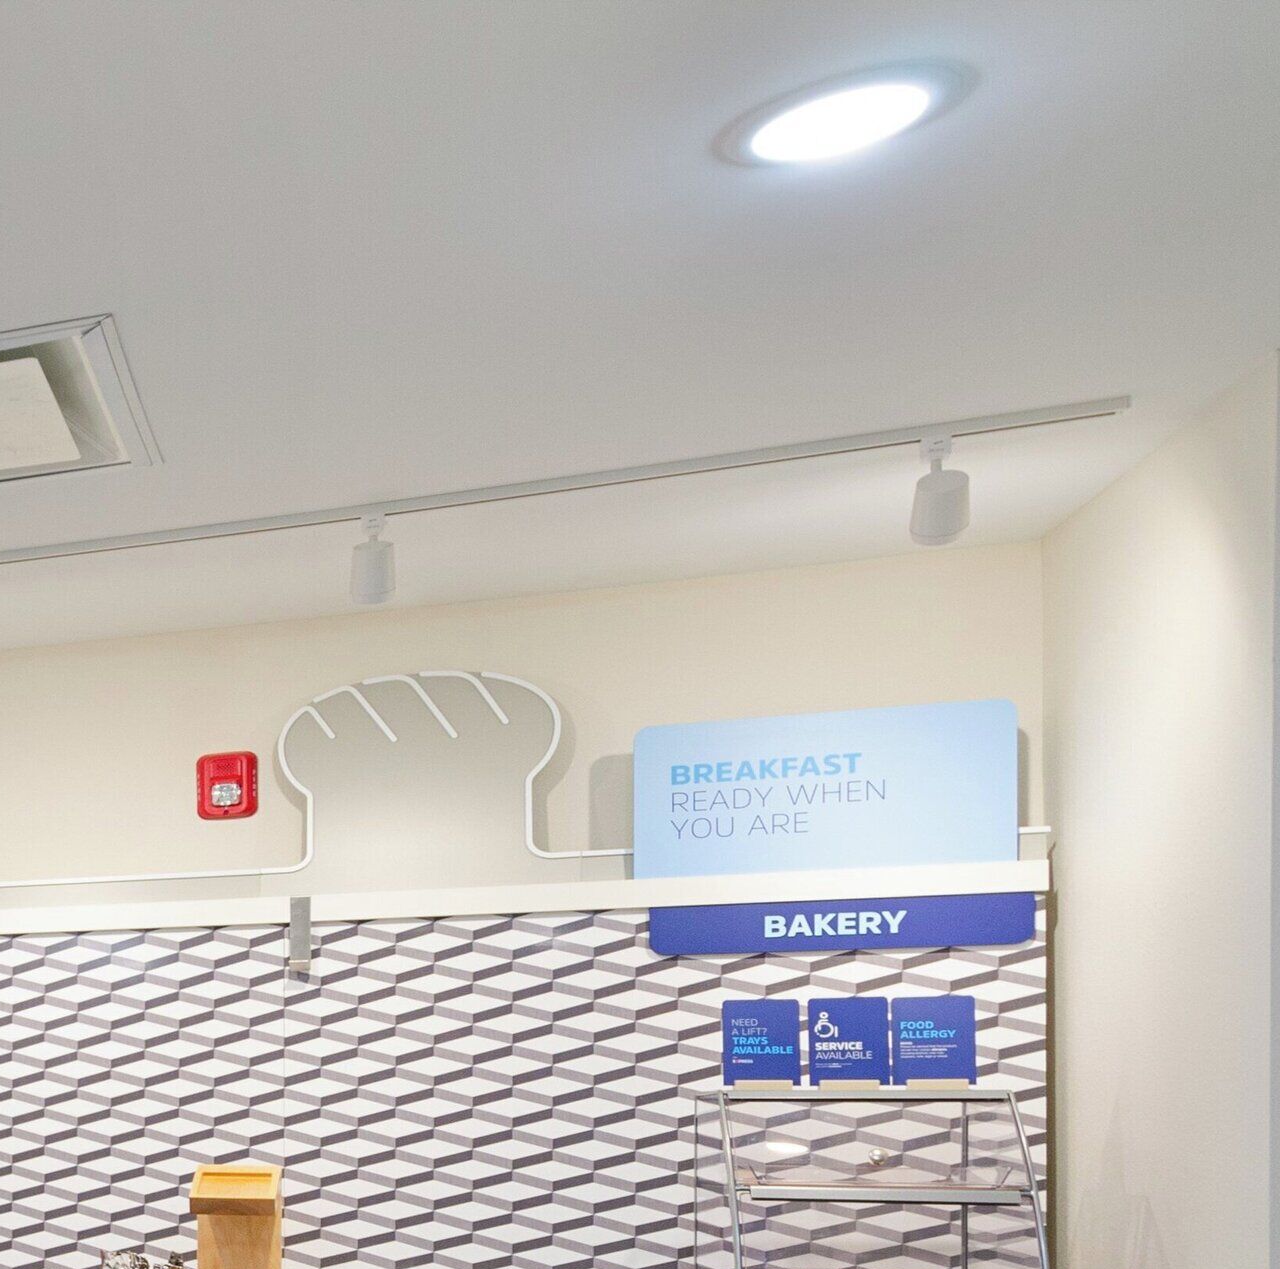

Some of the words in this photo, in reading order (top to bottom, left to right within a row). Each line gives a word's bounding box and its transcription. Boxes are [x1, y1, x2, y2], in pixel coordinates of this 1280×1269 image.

[670, 752, 862, 785] BREAKFAST
[671, 784, 773, 813] READY
[787, 778, 887, 807] WHEN
[670, 816, 735, 840] YOU
[748, 811, 809, 836] ARE
[764, 910, 908, 938] BAKERY
[731, 1018, 758, 1027] NEED
[900, 1020, 934, 1030] FOOD
[731, 1028, 739, 1036] A
[741, 1027, 768, 1036] LIFT?
[900, 1029, 957, 1039] ALLERGY
[732, 1036, 769, 1045] TRAYS
[732, 1045, 794, 1055] AVAILABLE
[815, 1041, 863, 1051] SERVICE
[815, 1050, 873, 1060] AVAILABLE
